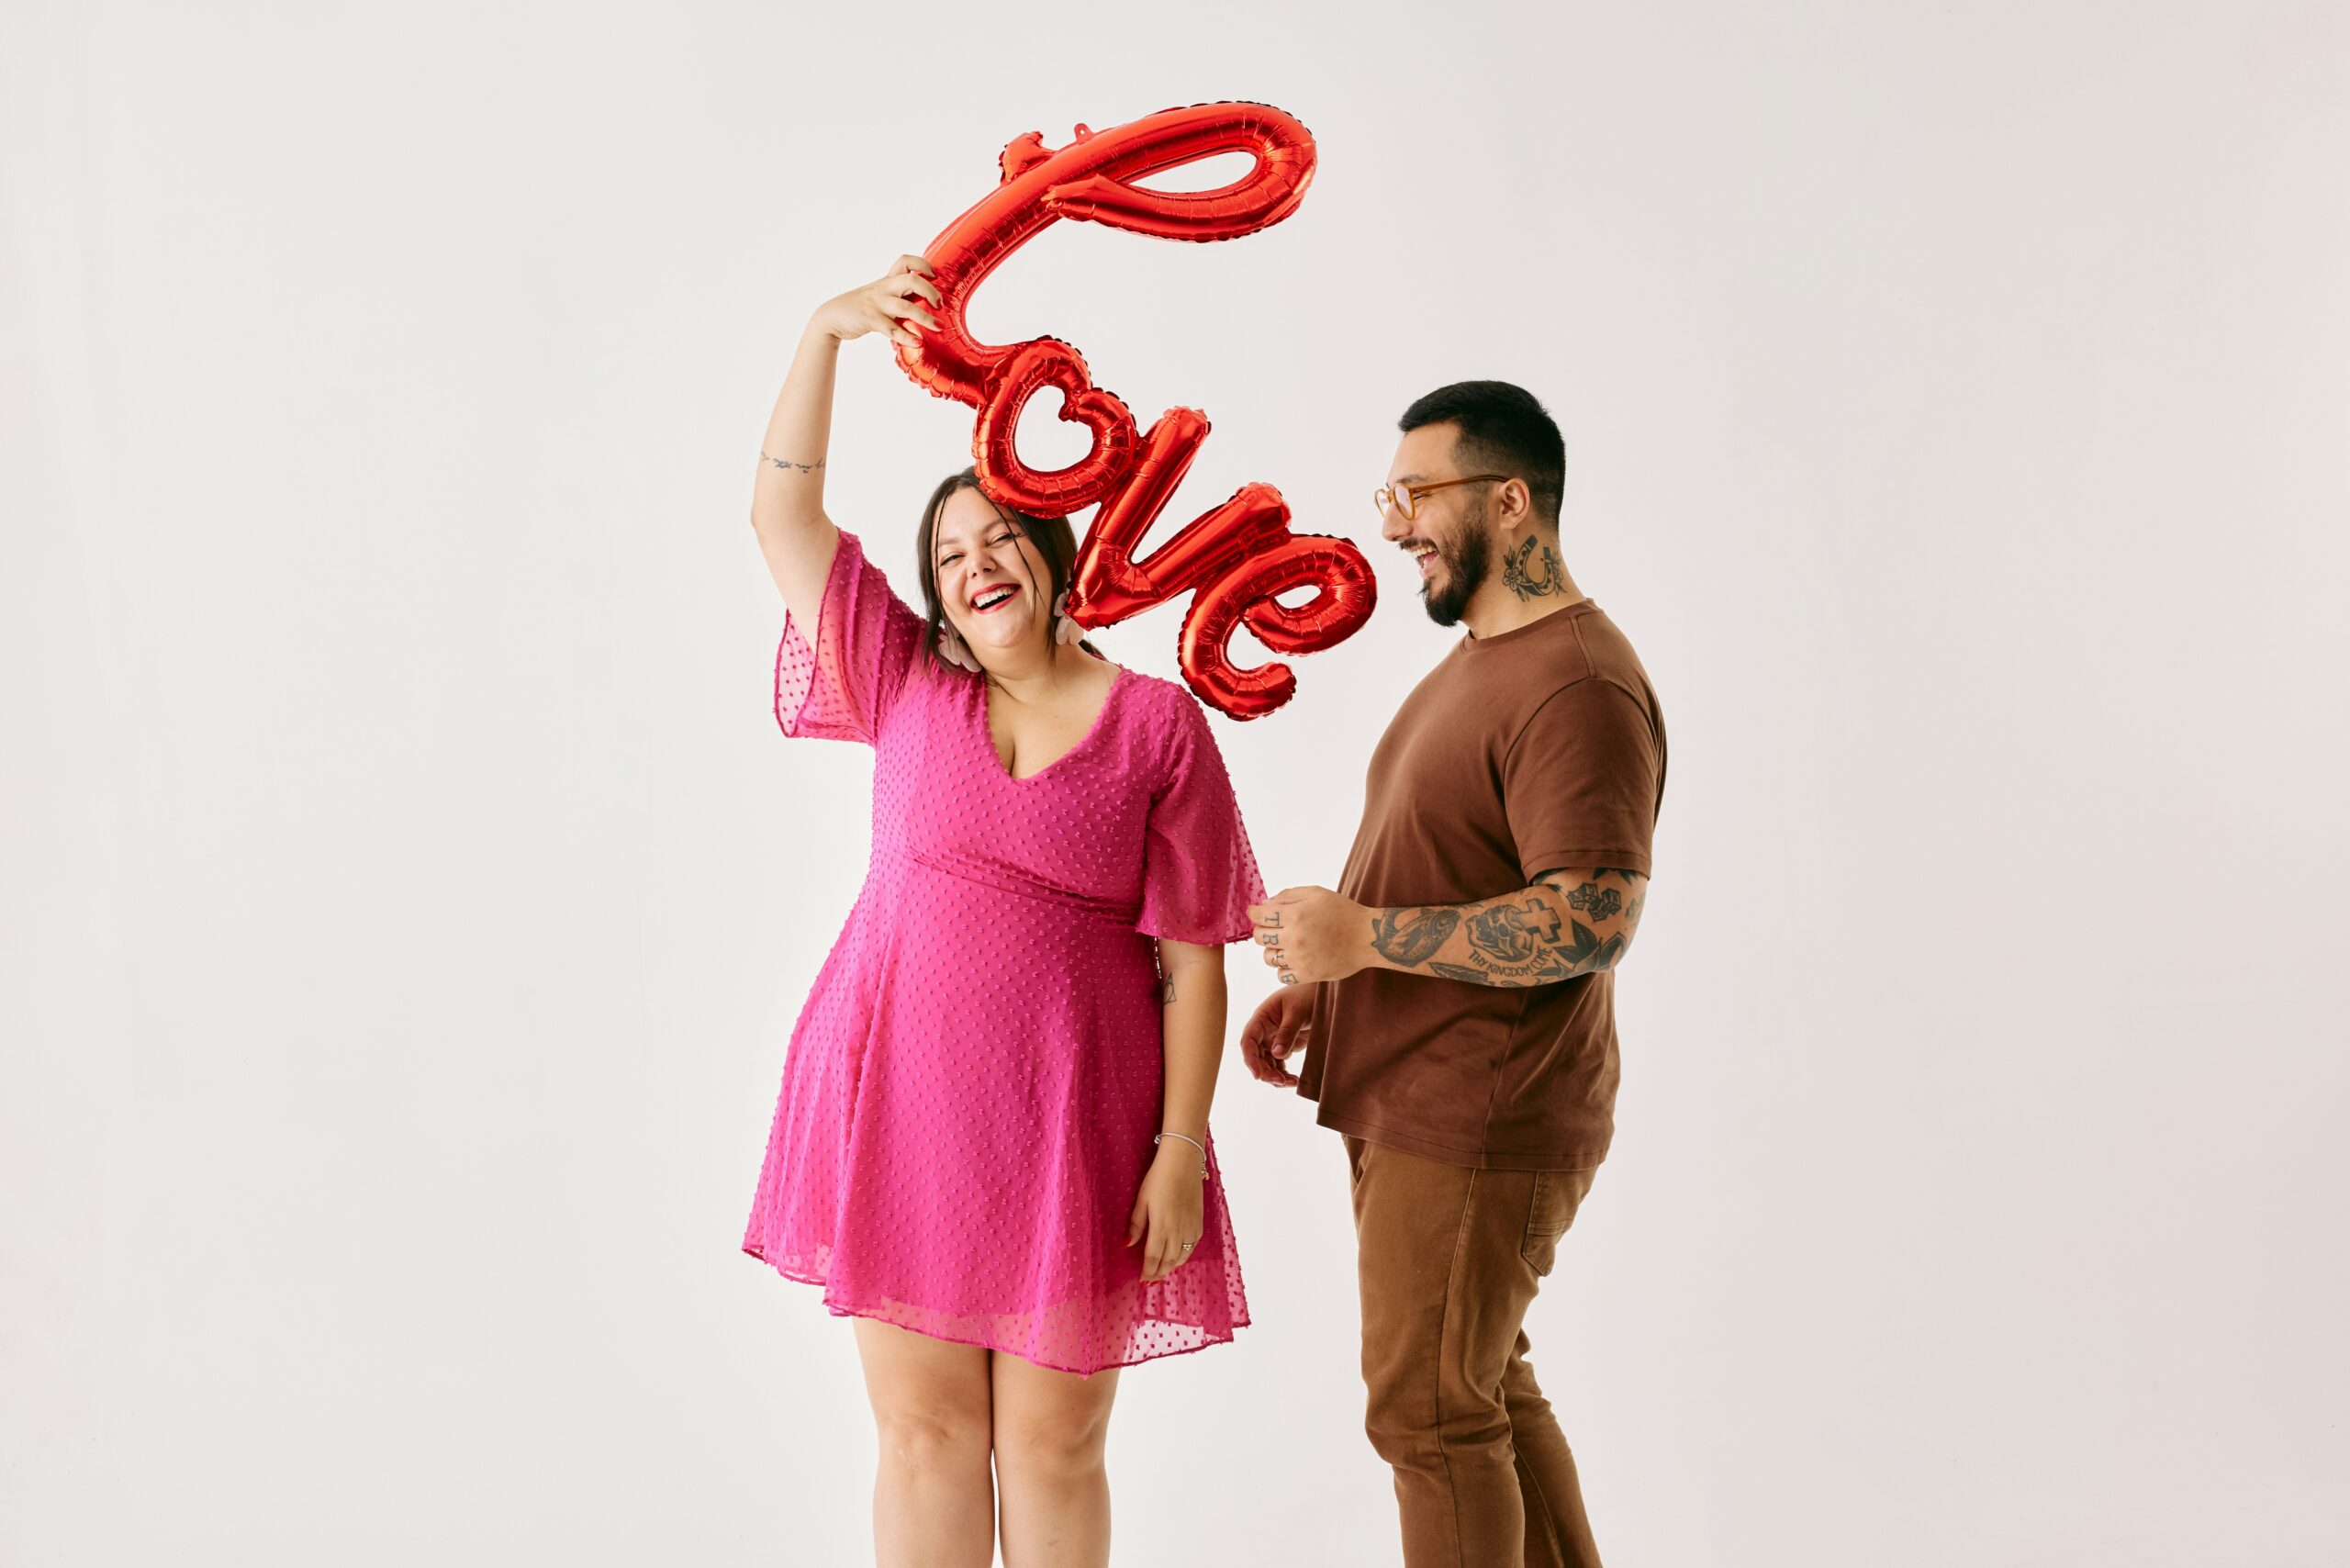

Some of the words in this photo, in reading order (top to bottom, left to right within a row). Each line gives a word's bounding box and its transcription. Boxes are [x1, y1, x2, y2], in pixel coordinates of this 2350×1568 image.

[1262, 911, 1300, 985] TRUE
[1469, 948, 1489, 968] THY
[1486, 961, 1535, 978] KINGDOM
[1530, 945, 1553, 970] COME
